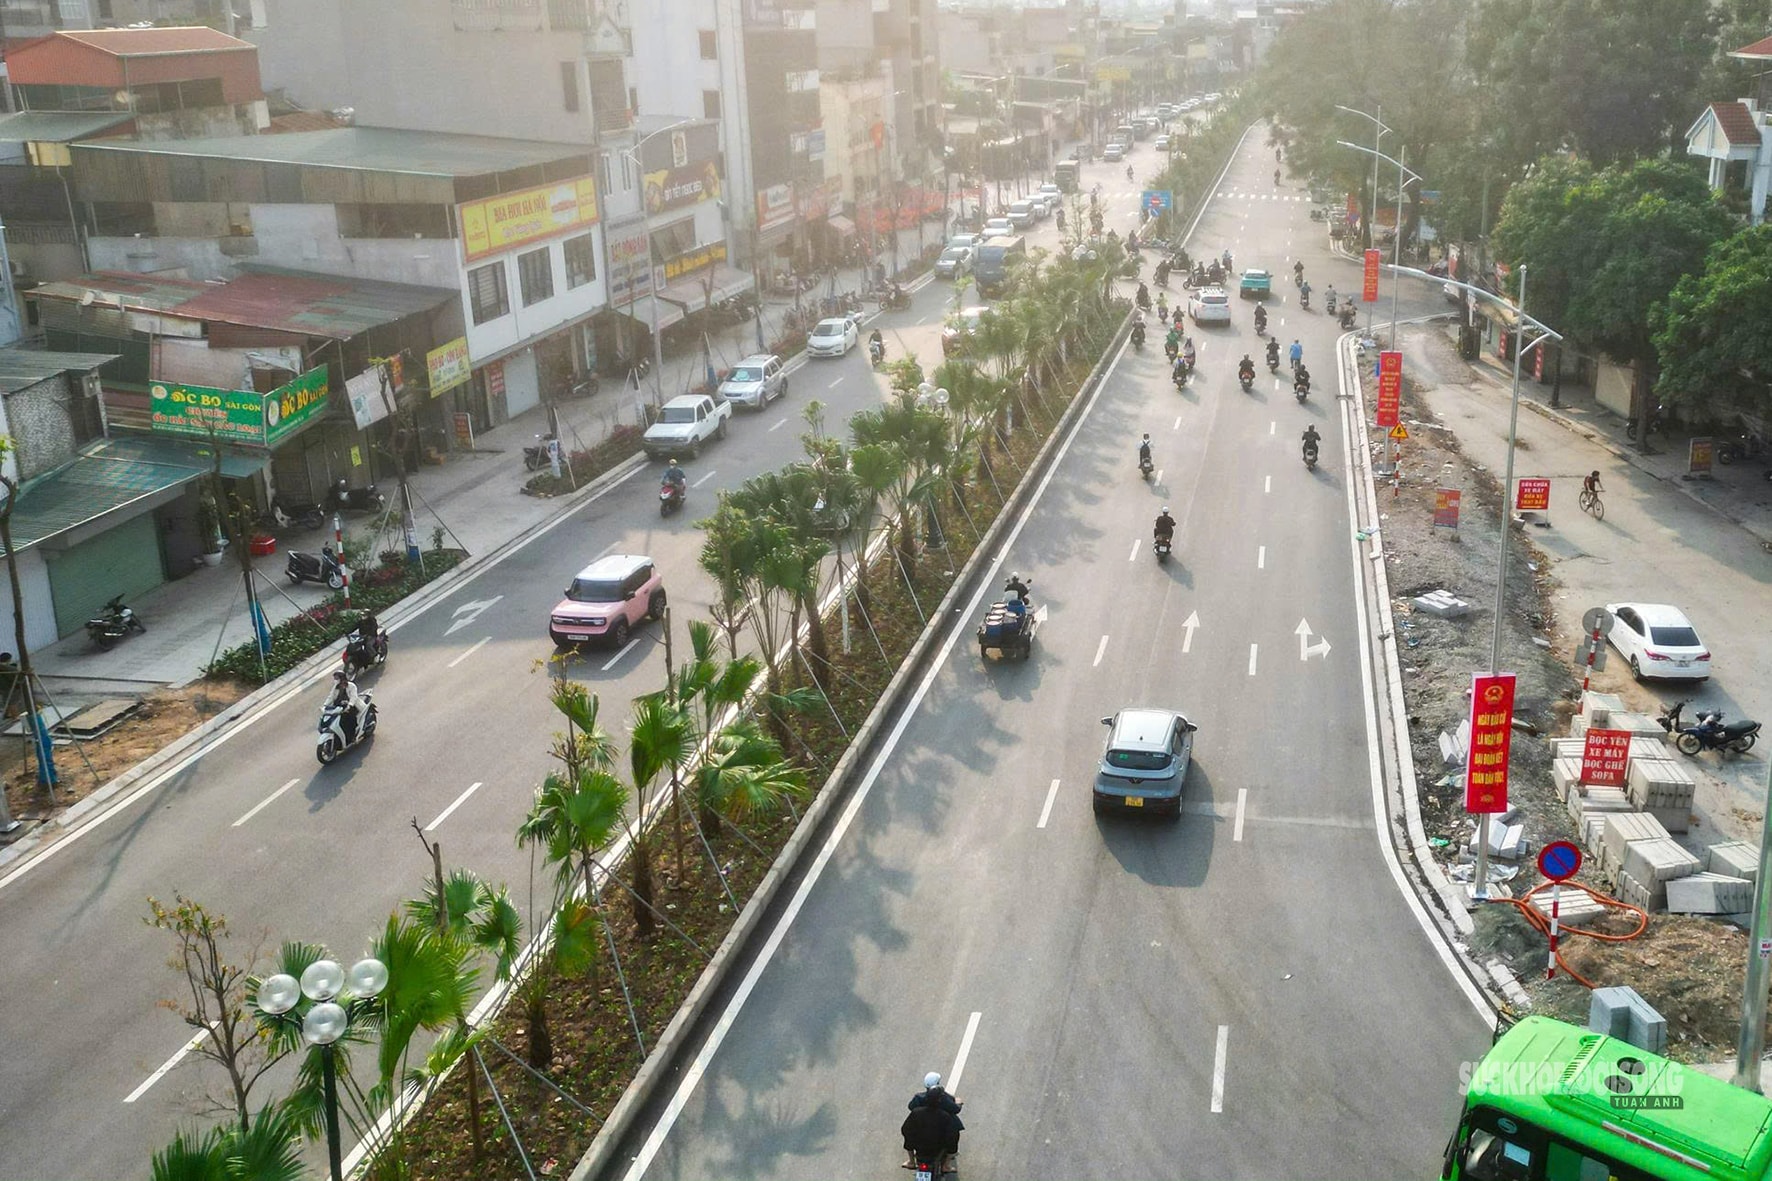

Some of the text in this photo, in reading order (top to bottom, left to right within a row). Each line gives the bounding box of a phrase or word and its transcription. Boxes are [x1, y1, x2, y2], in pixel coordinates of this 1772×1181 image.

[1589, 735, 1628, 746] BỌC YÊN
[1589, 747, 1625, 758] XE MÁY
[1584, 759, 1603, 769] BỌC
[1591, 770, 1614, 780] SOFA
